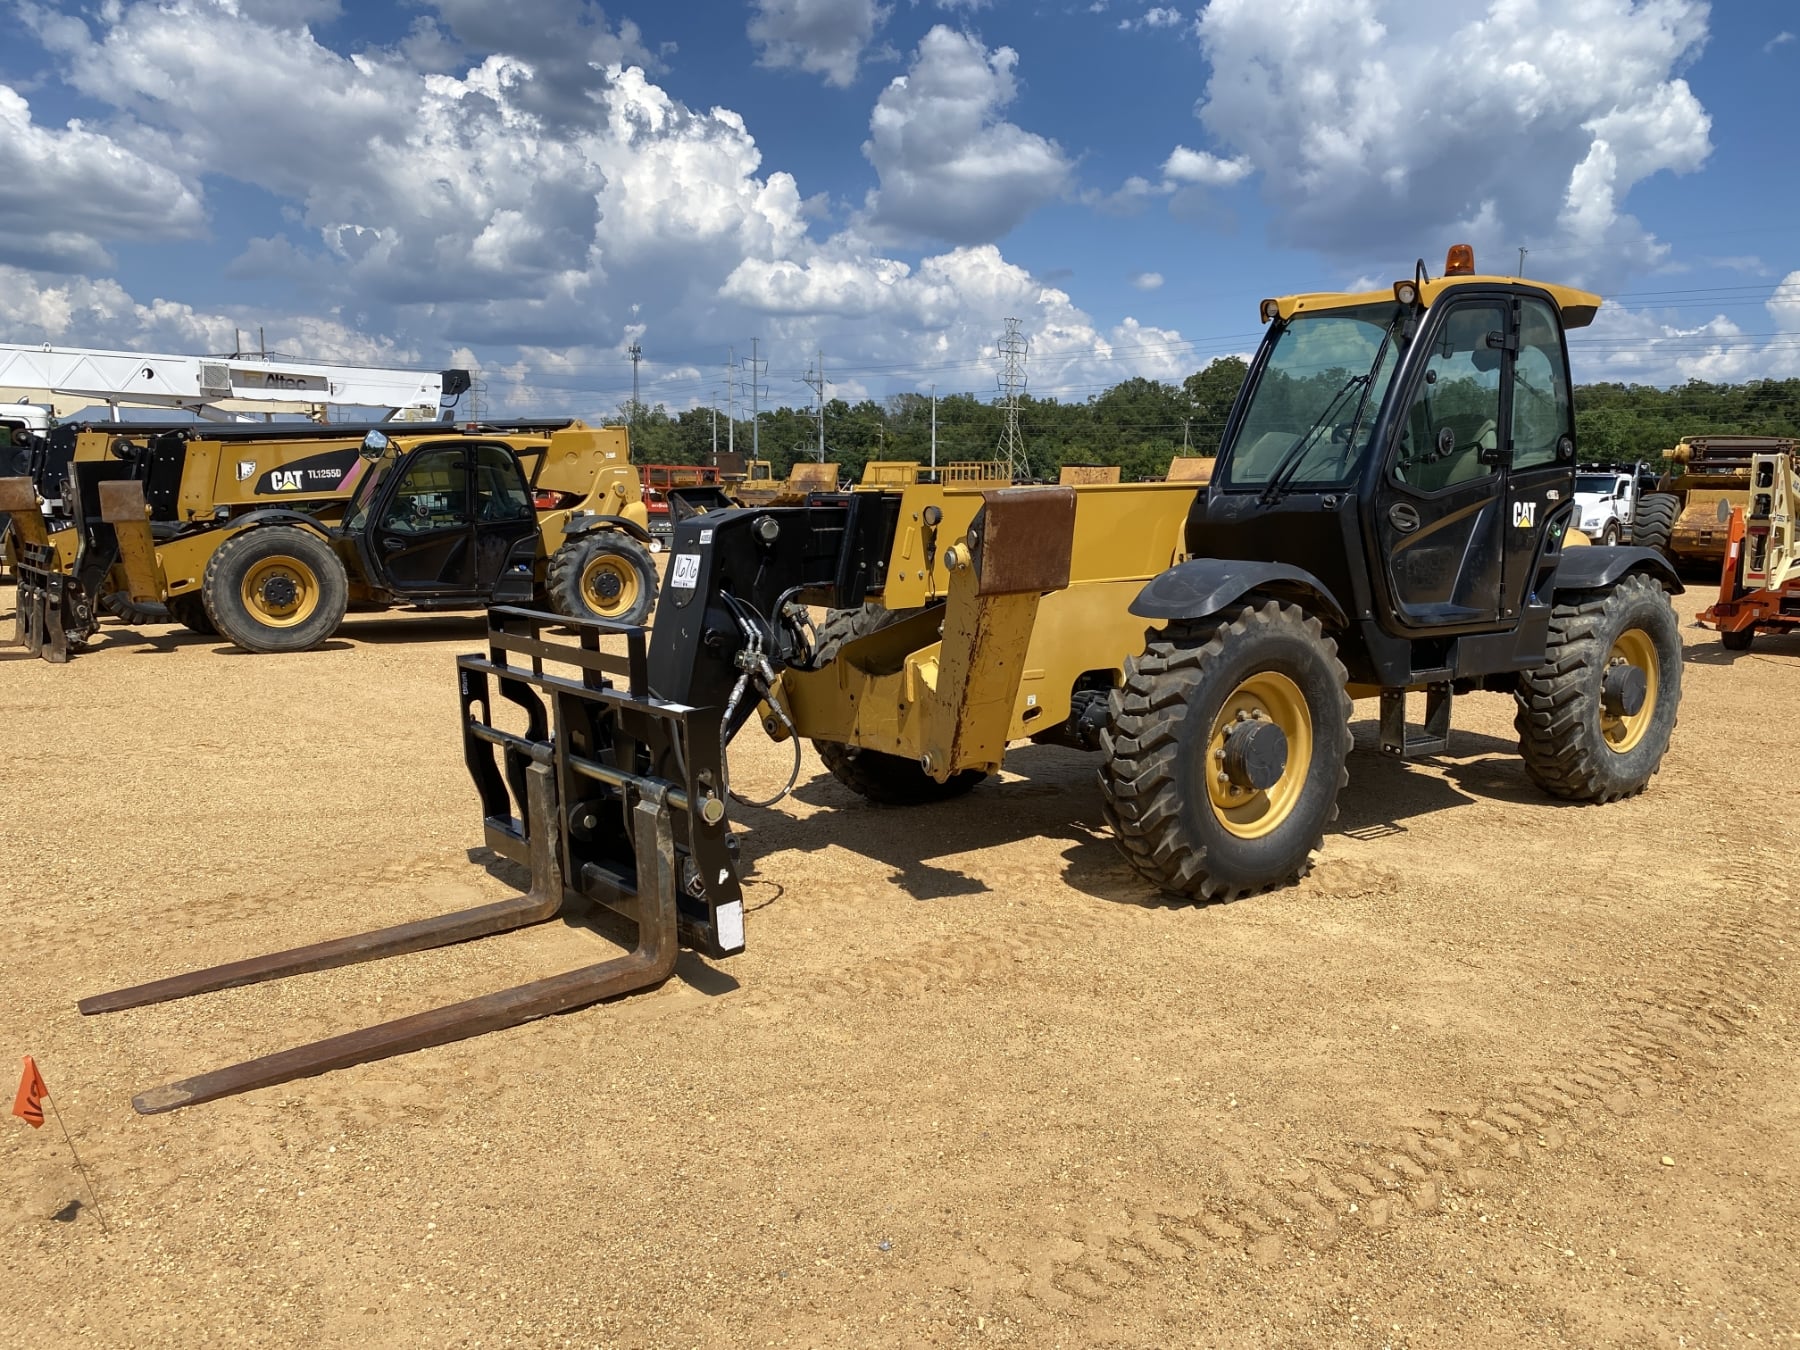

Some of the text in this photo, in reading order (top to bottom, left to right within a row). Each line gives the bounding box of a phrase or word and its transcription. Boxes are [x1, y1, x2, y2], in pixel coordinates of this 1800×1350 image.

[266, 373, 307, 390] Altec
[271, 468, 341, 491] CAT TL1255D
[1513, 501, 1537, 527] CAT
